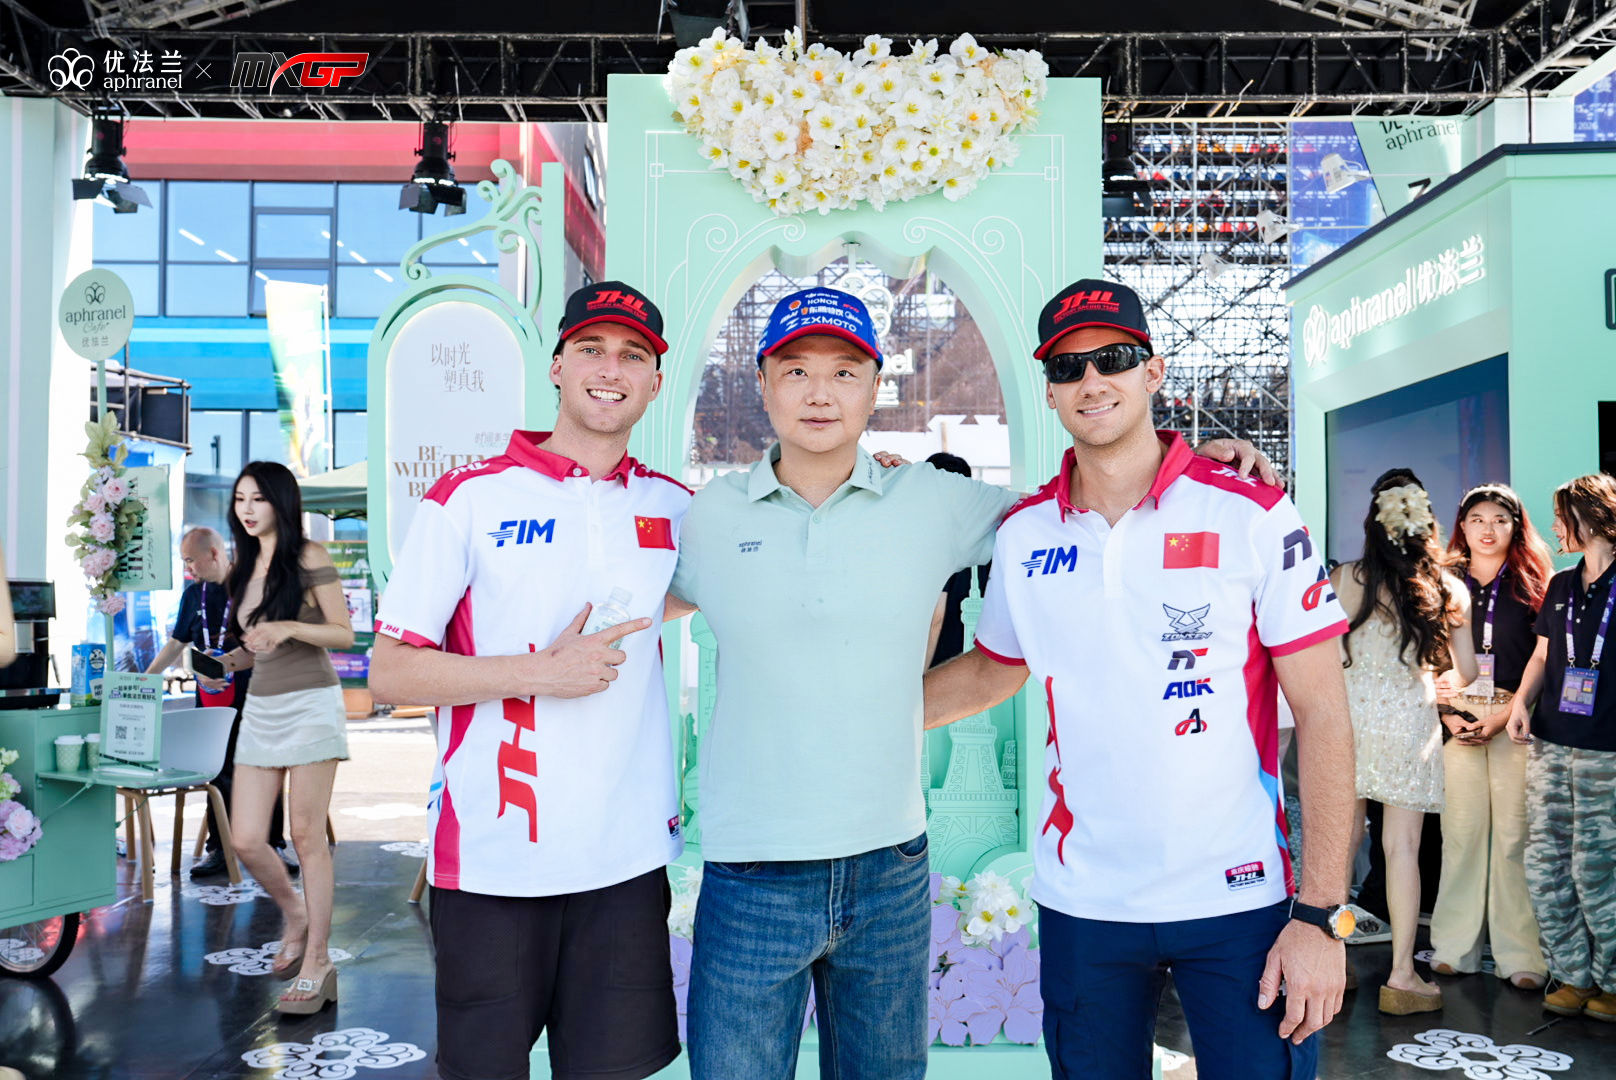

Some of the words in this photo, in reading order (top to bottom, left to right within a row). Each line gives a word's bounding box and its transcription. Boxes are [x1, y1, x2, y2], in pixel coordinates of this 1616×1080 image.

[1385, 120, 1460, 150] aphranel
[1330, 267, 1413, 349] aphranel
[1417, 234, 1485, 304] 优法兰
[65, 304, 126, 326] aphranel
[801, 316, 857, 332] ZXMOTO
[431, 342, 472, 369] 以时光
[443, 368, 485, 392] 塑真我
[419, 446, 442, 461] BE
[394, 461, 444, 478] WITH
[448, 461, 490, 480] JHL
[487, 518, 556, 548] FIM
[1021, 545, 1078, 577] FIM
